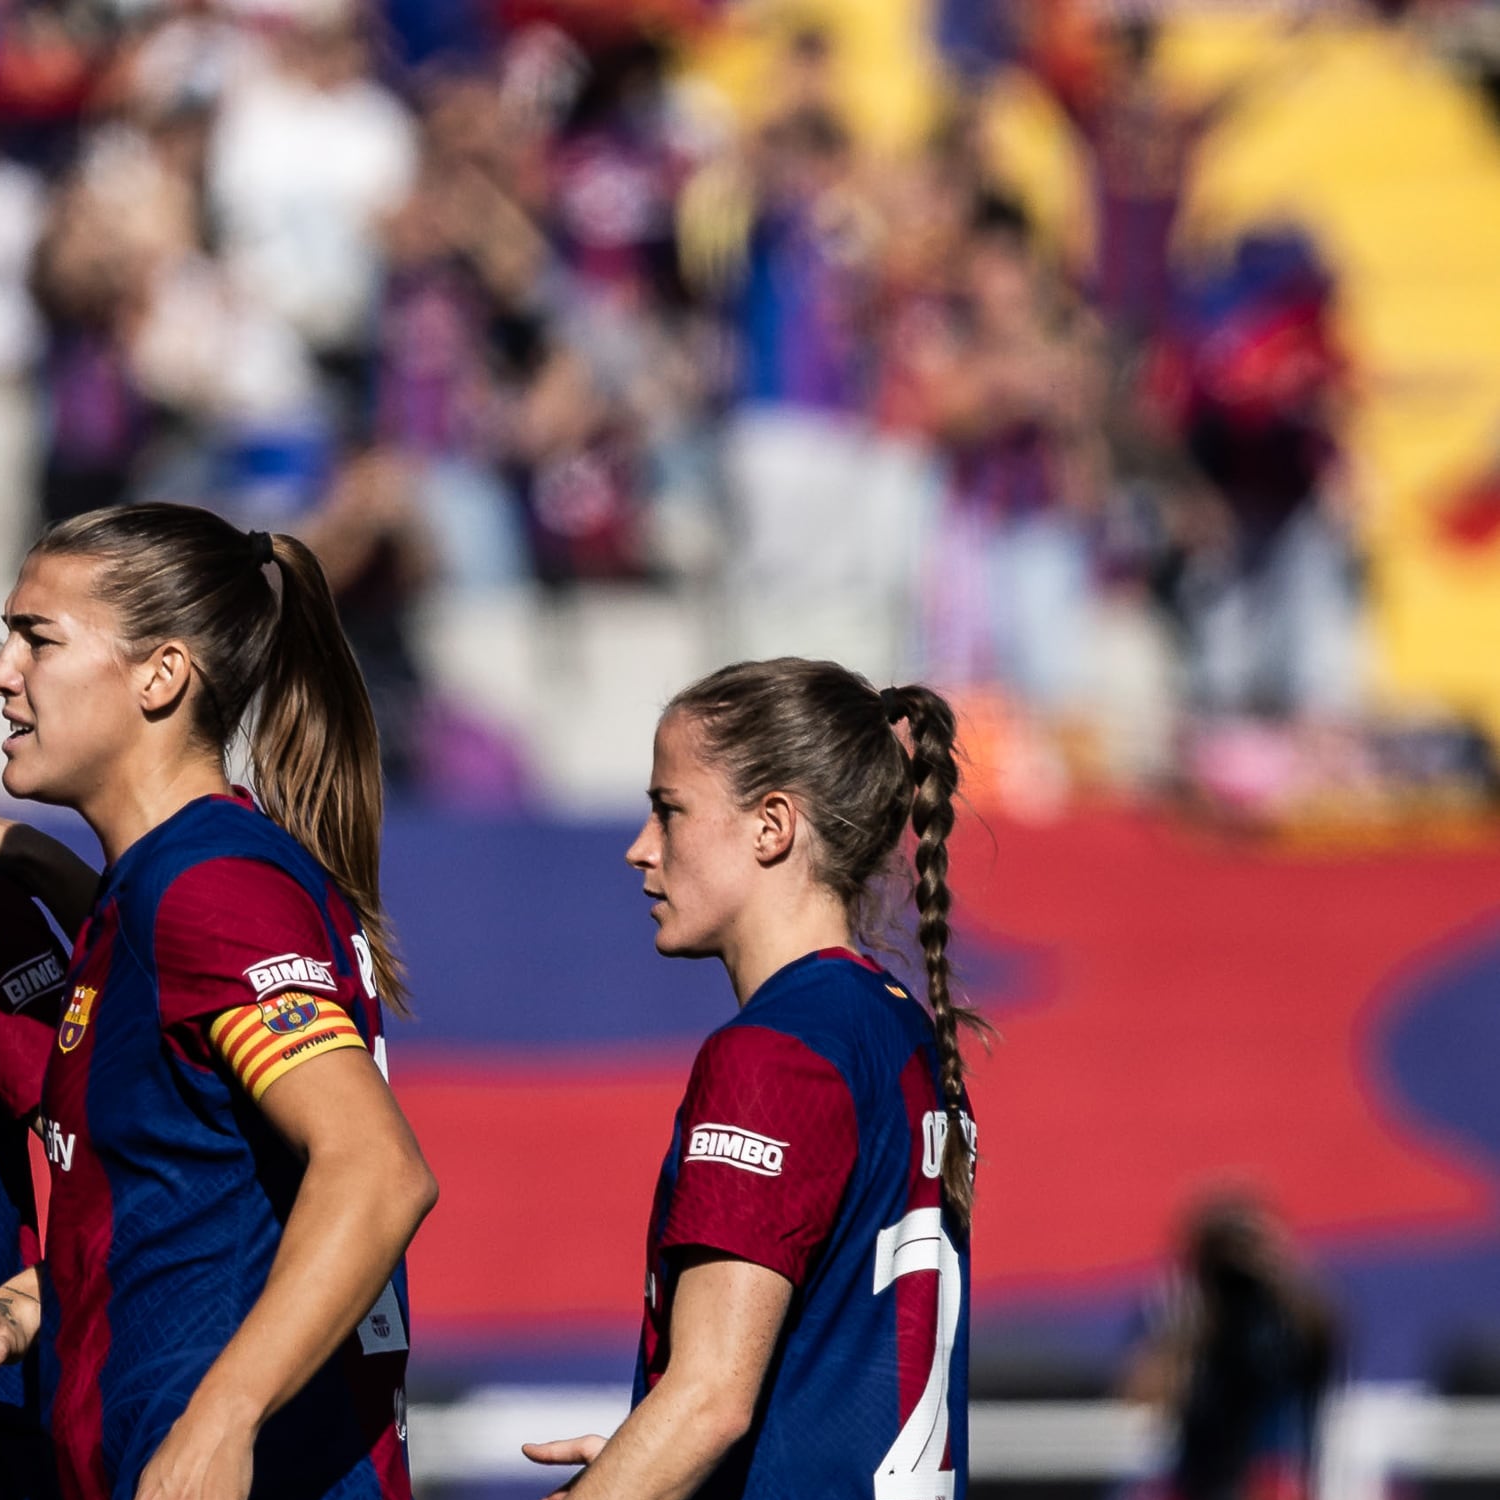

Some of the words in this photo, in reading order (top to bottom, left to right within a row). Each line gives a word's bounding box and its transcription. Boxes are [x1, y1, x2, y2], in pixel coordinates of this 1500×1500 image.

[248, 957, 336, 993] BIMBO
[281, 1030, 339, 1061] CAPITANA
[688, 1131, 784, 1171] BIMBO
